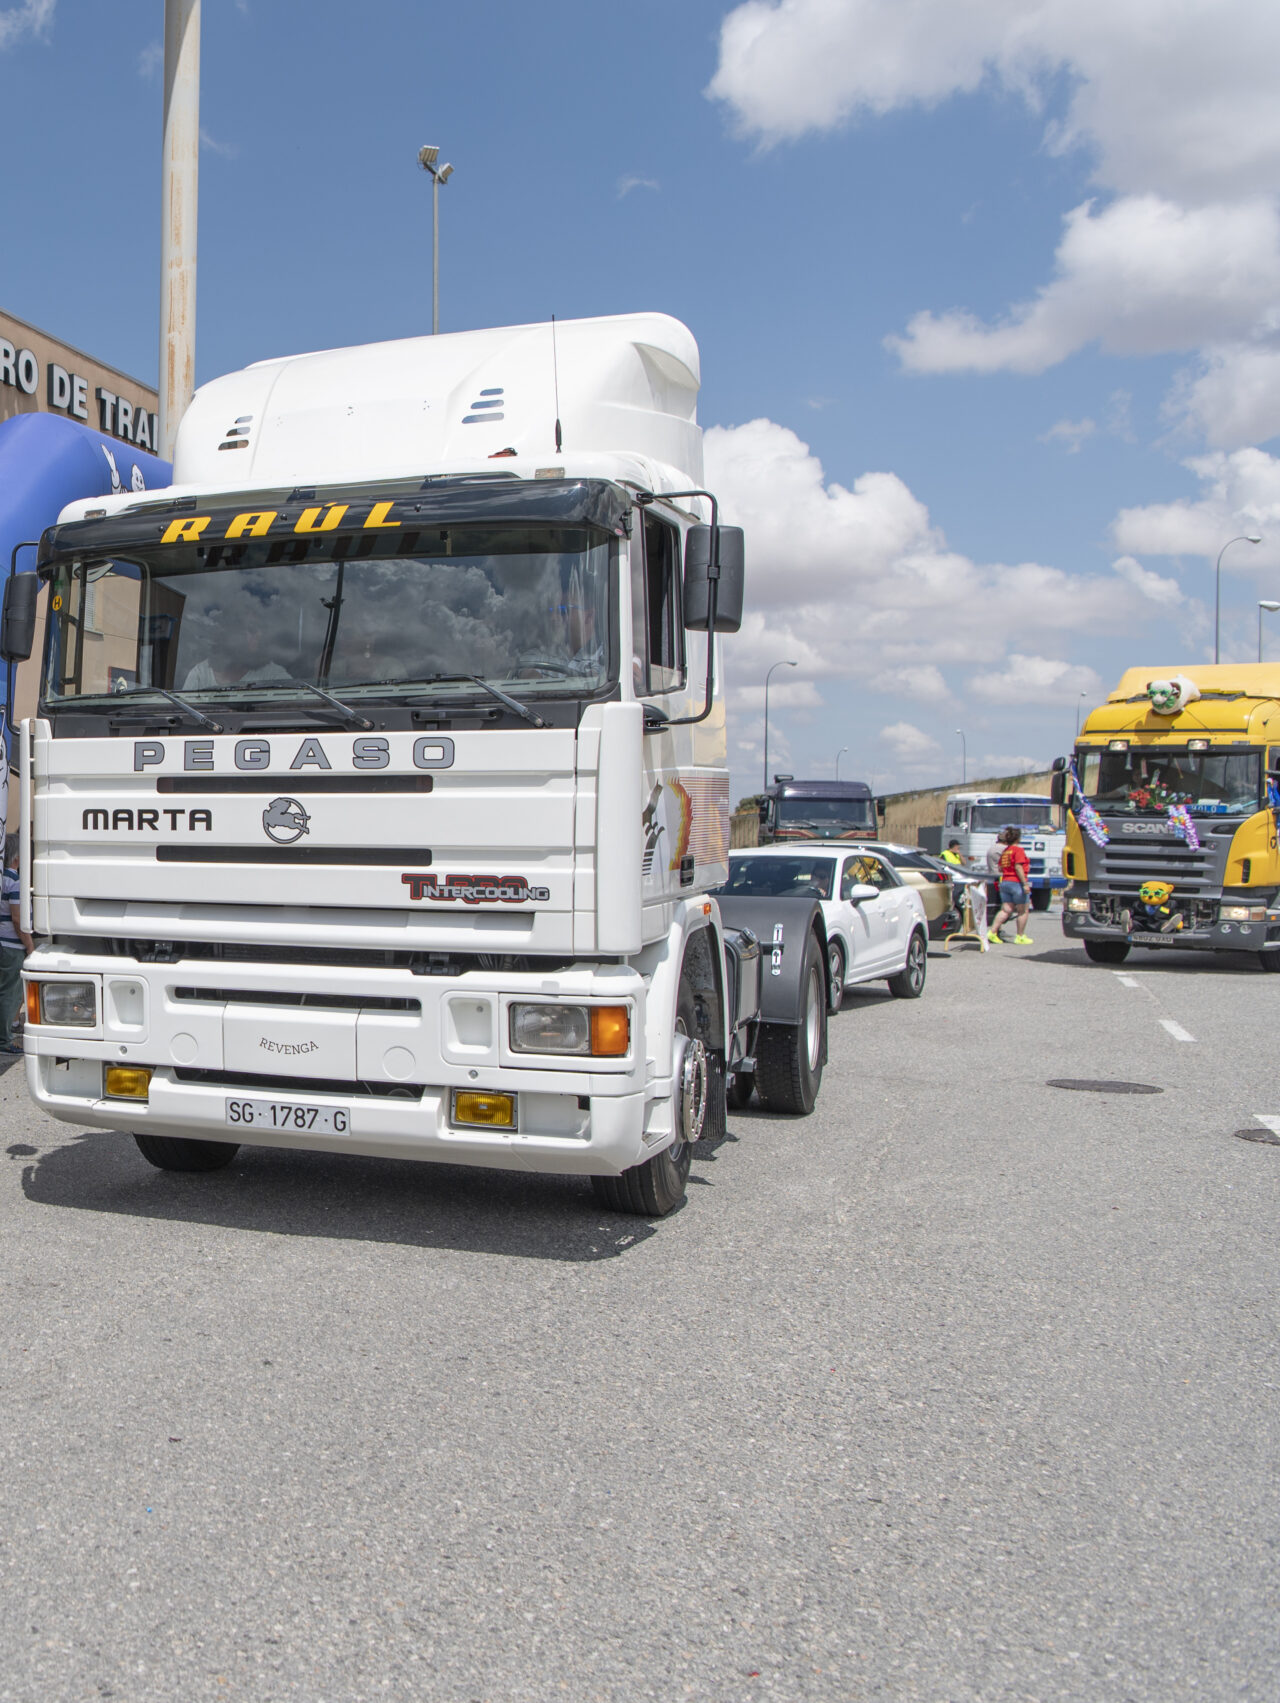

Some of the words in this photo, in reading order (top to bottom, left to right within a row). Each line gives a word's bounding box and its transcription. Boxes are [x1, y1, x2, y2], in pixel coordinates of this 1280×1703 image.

[47, 363, 89, 420] DE
[160, 501, 402, 544] RAÚL
[134, 737, 455, 772] PEGASO
[82, 808, 212, 831] MARTA
[1122, 822, 1175, 835] SCAN
[423, 884, 551, 902] INTERCOOLING
[259, 1037, 320, 1056] REVENGA
[270, 1104, 319, 1130] 1787
